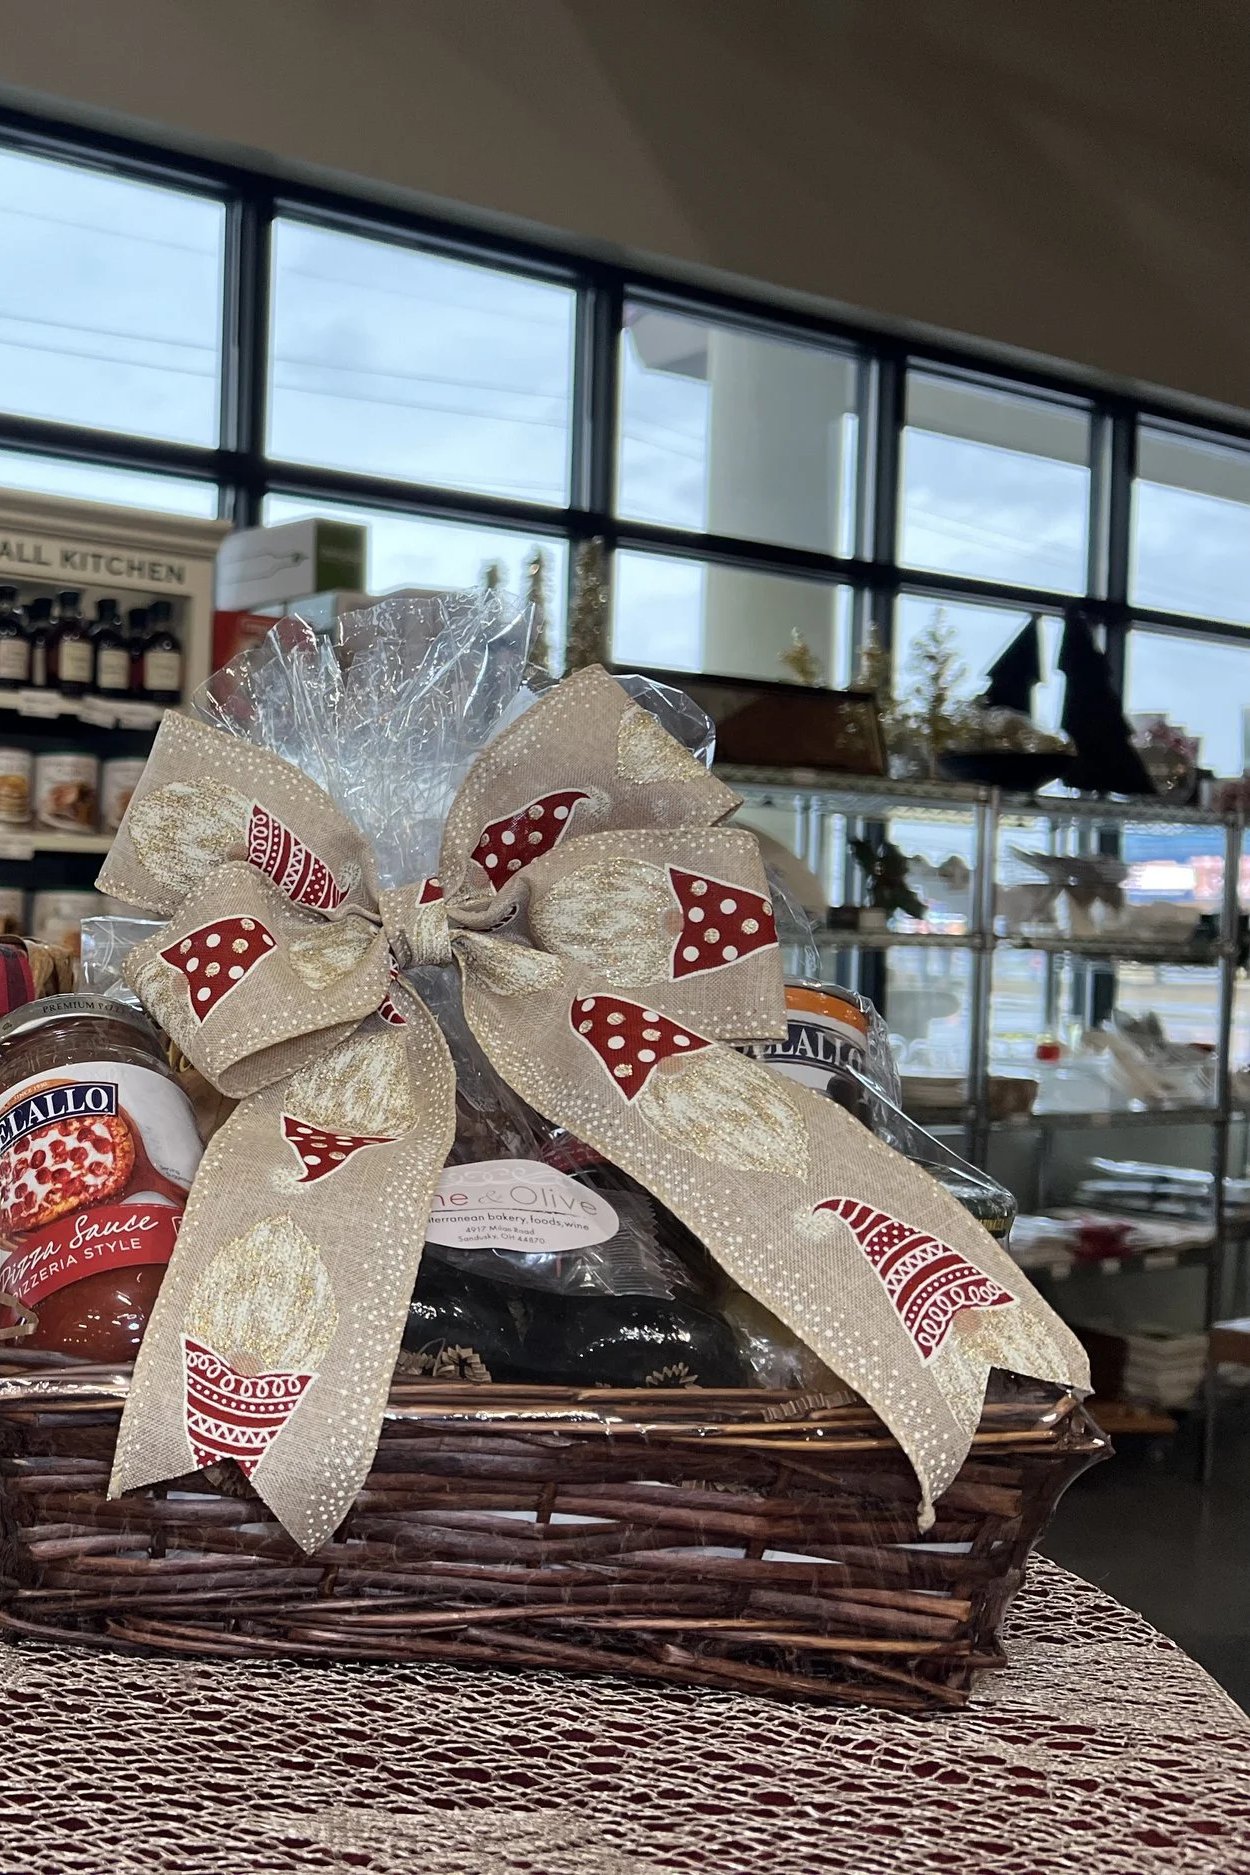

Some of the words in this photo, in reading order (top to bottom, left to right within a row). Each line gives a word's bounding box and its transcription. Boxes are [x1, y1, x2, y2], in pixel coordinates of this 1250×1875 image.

[59, 547, 186, 585] KITCHEN
[42, 1001, 95, 1014] PREMIUM
[510, 1186, 598, 1217] Olive
[69, 1214, 159, 1250] Sauce
[465, 1225, 487, 1233] 4917
[513, 1226, 535, 1236] Road
[517, 1235, 546, 1245] 44870
[83, 1237, 142, 1260] STYLE
